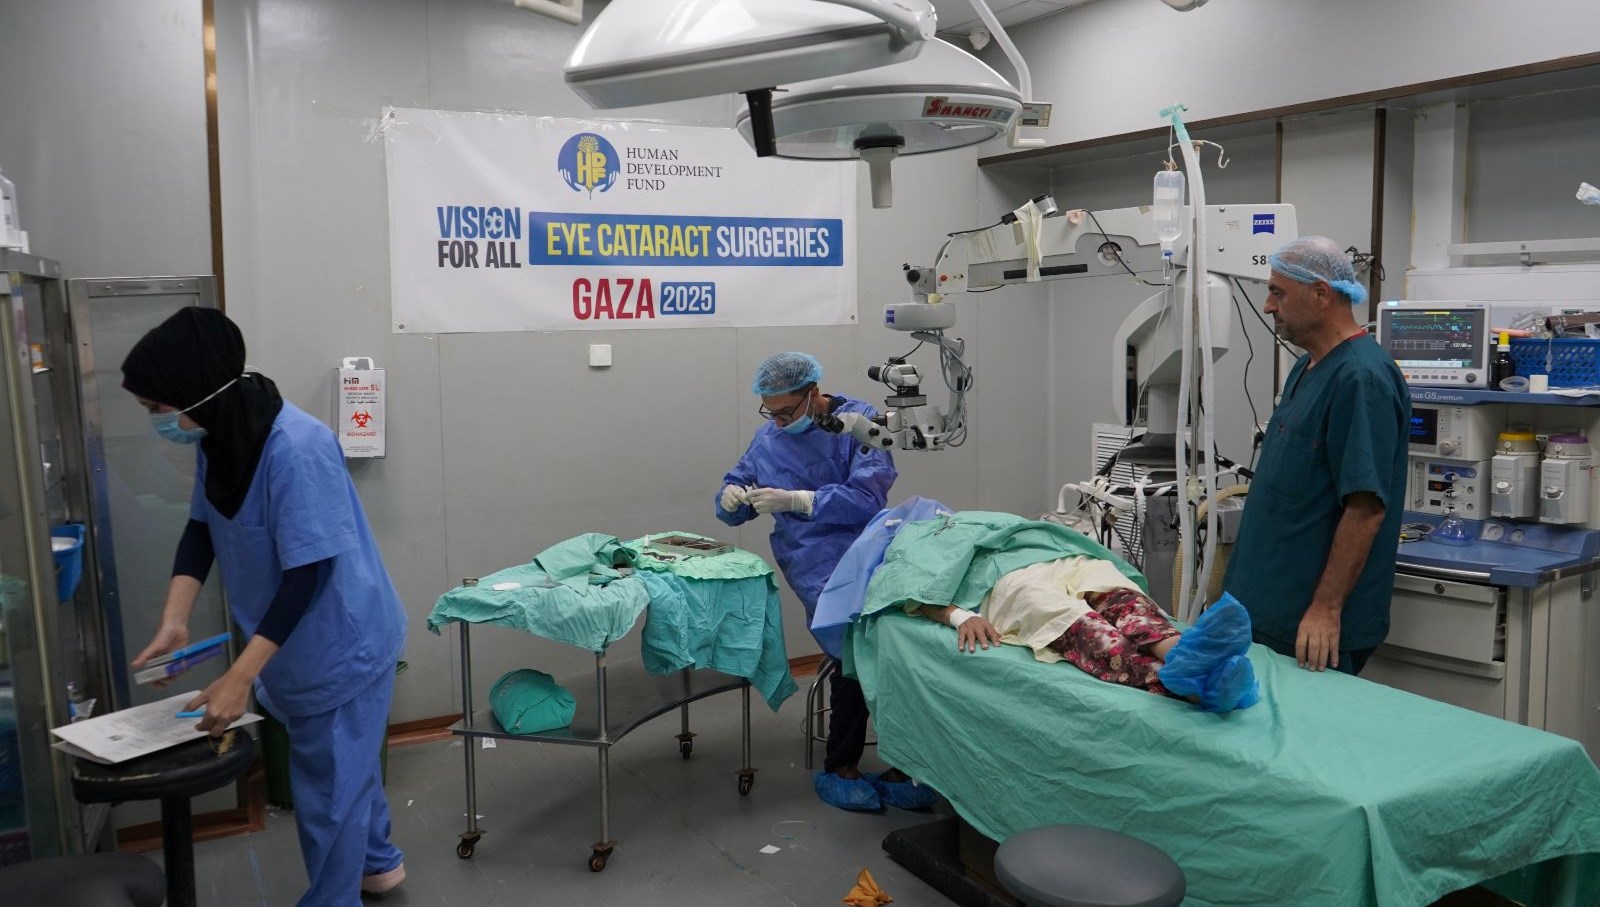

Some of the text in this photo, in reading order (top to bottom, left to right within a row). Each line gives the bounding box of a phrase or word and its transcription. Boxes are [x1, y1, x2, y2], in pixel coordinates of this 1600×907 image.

[627, 147, 679, 161] HUMAN
[627, 163, 723, 178] DEVELOPMENT
[627, 179, 665, 191] FUND
[436, 205, 521, 239] VISION
[547, 222, 830, 258] EYE CATARACT SURGERIES
[438, 240, 521, 269] FOR ALL
[572, 277, 713, 321] GAZA 2025
[1424, 391, 1437, 400] GS
[1437, 394, 1463, 402] premium
